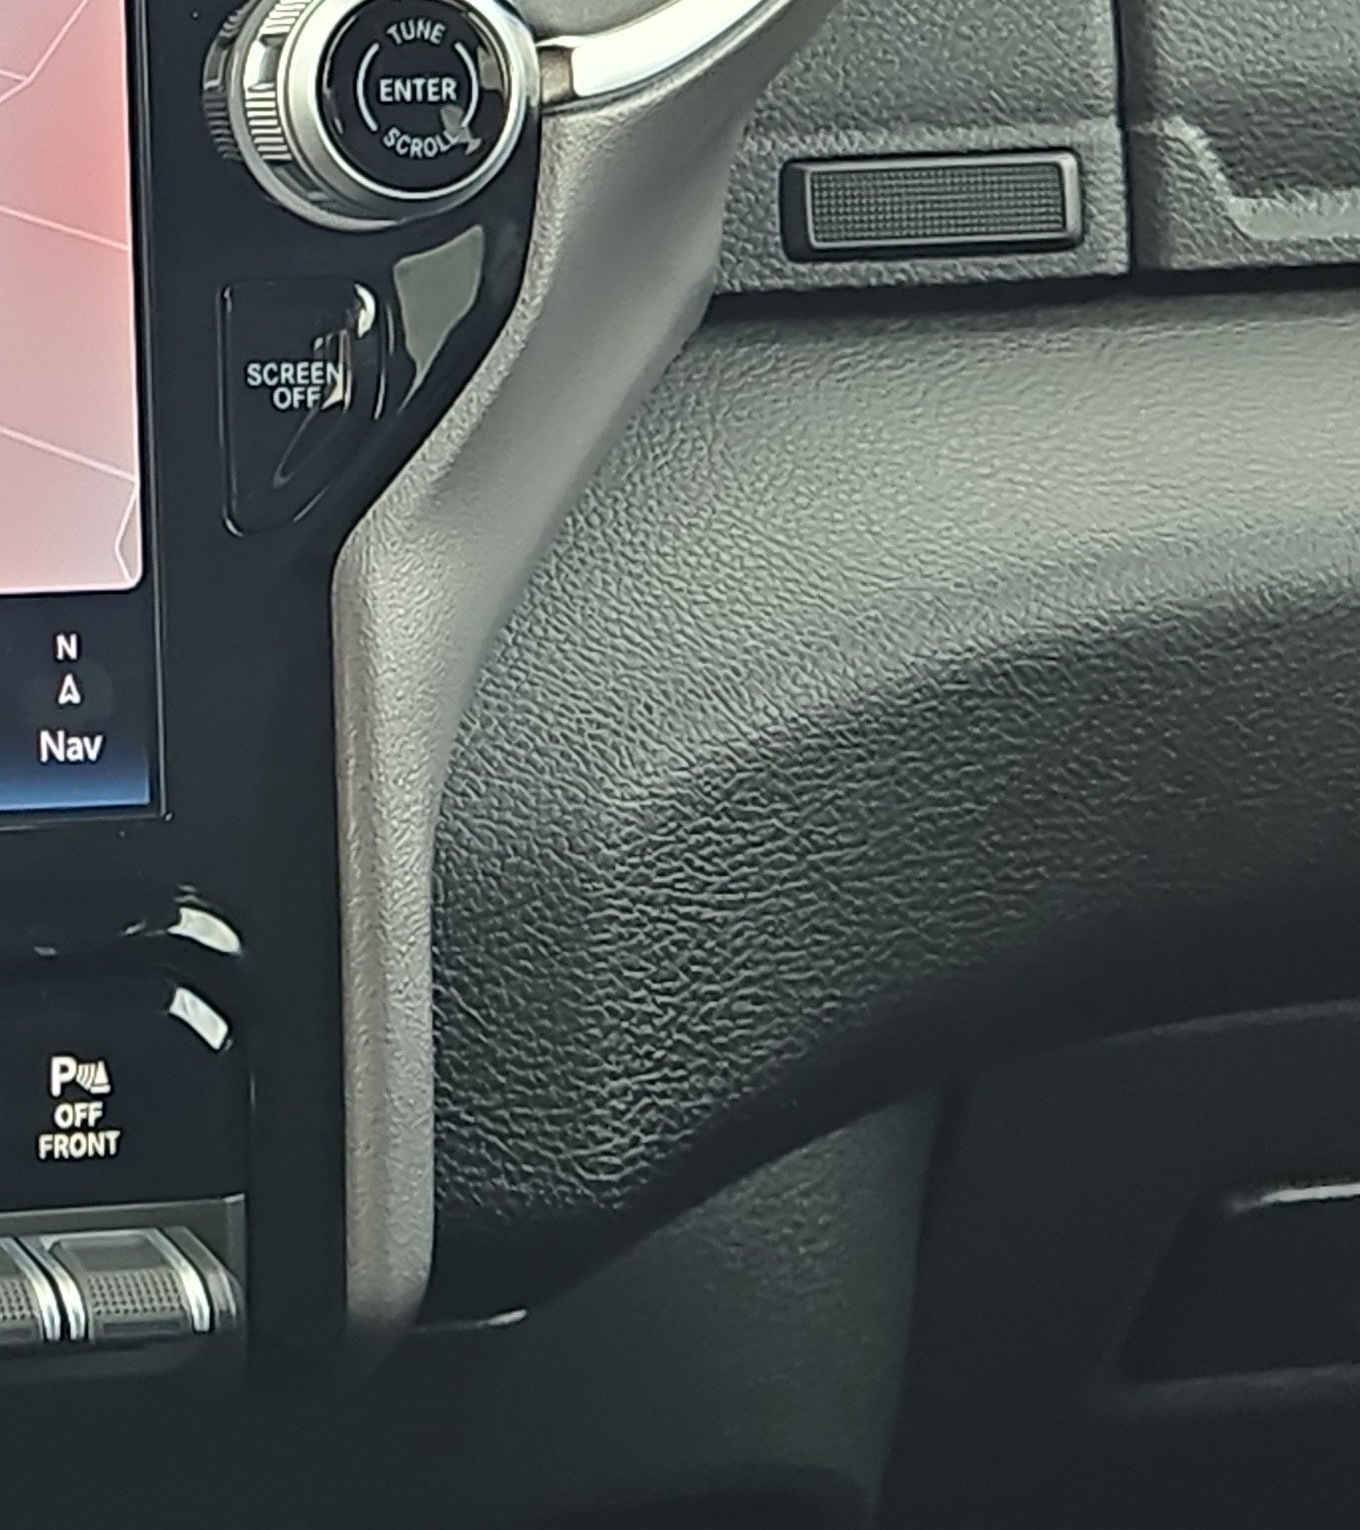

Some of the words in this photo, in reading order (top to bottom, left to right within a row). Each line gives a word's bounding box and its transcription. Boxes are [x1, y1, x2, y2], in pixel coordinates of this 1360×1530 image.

[385, 17, 447, 46] TUNE
[379, 78, 458, 103] ENTER
[382, 126, 461, 158] SCROLL
[246, 361, 344, 386] SCREEN
[272, 387, 323, 411] OFF
[54, 634, 78, 660] N
[38, 729, 104, 765] Nav
[54, 1101, 103, 1128] OFF
[38, 1130, 121, 1160] FRONT
